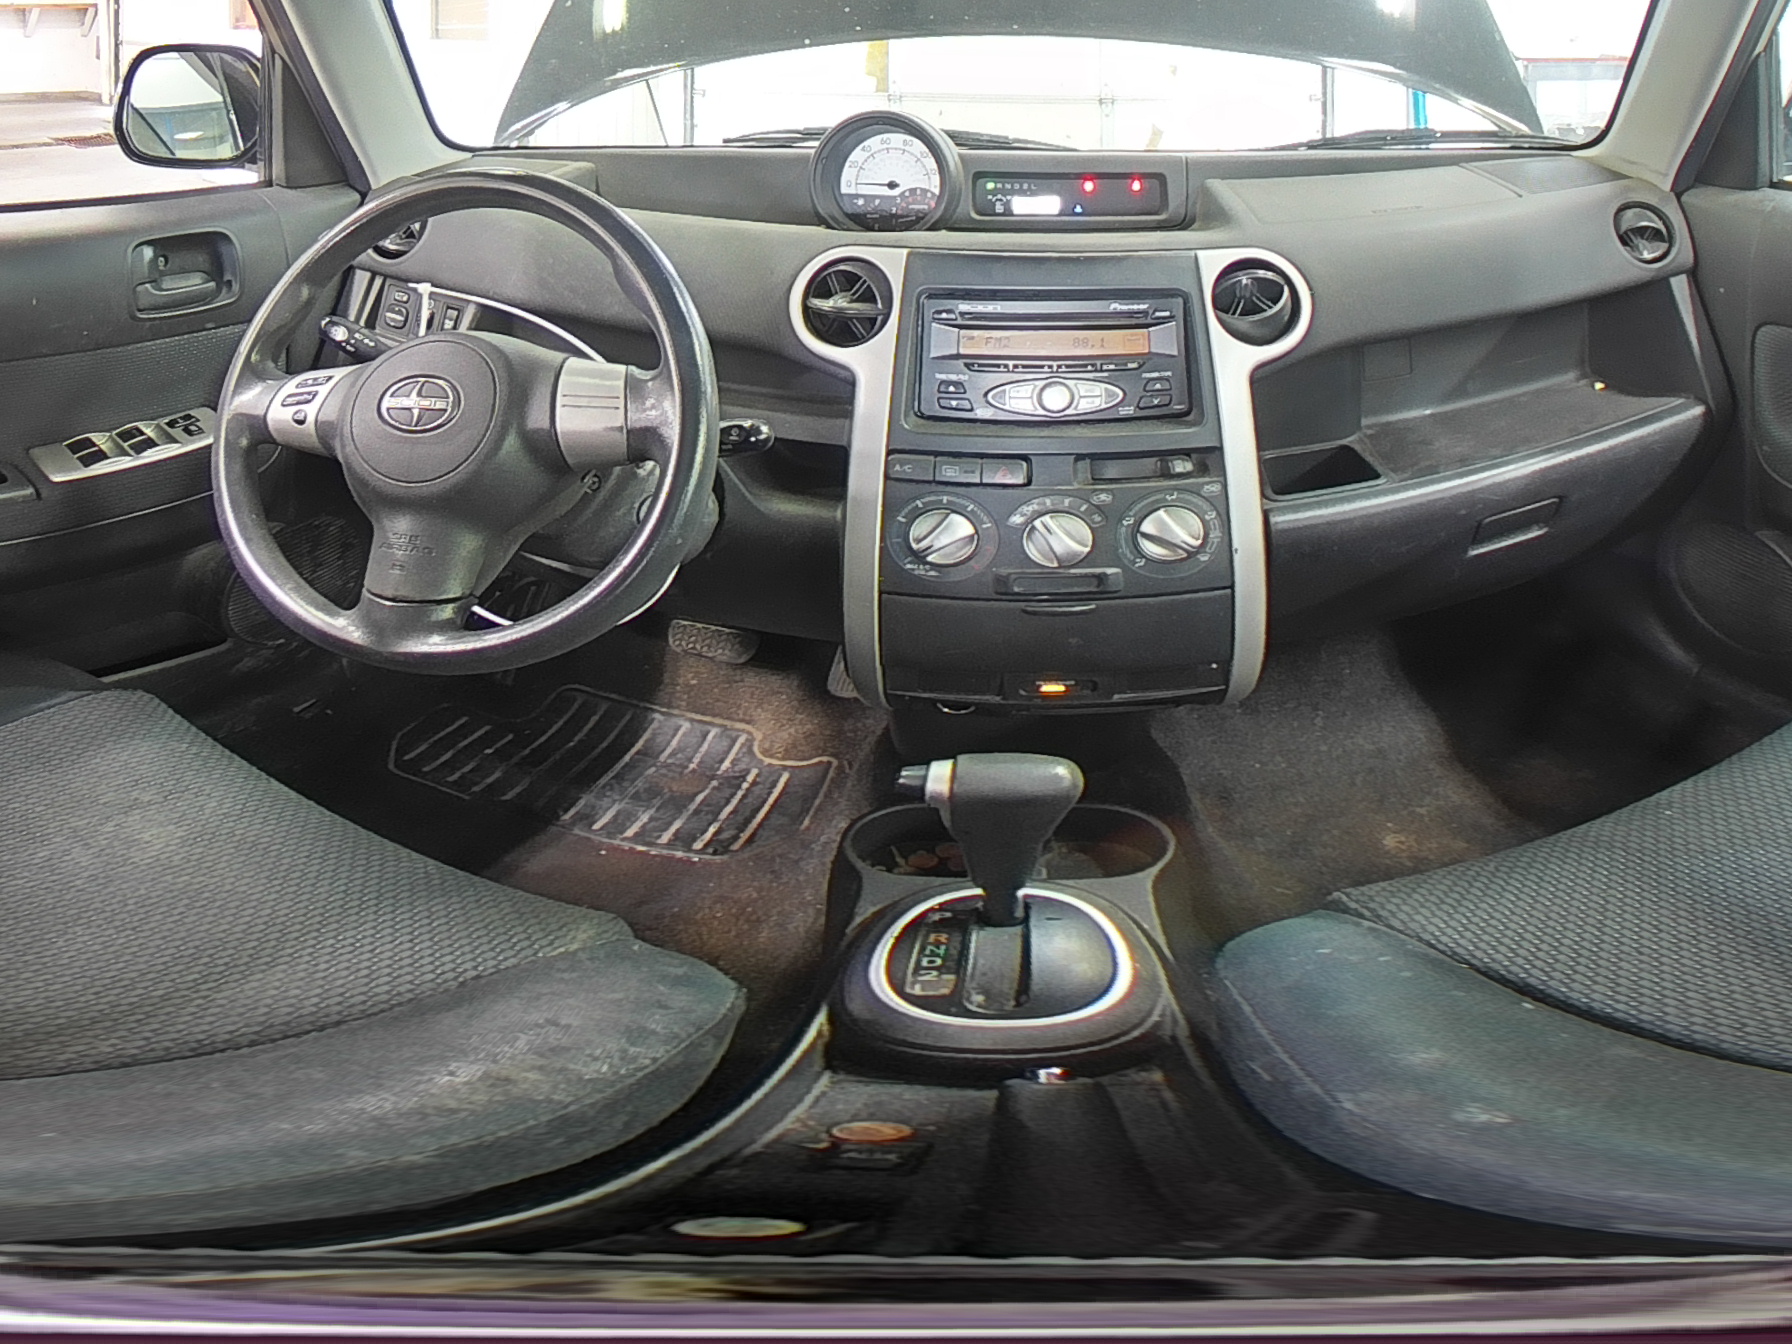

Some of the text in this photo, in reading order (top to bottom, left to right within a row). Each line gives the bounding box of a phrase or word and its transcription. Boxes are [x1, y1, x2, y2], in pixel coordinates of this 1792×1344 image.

[848, 160, 859, 169] 20
[861, 145, 873, 153] 40
[880, 137, 892, 146] 60
[903, 139, 914, 148] 80
[894, 463, 913, 472] A/C
